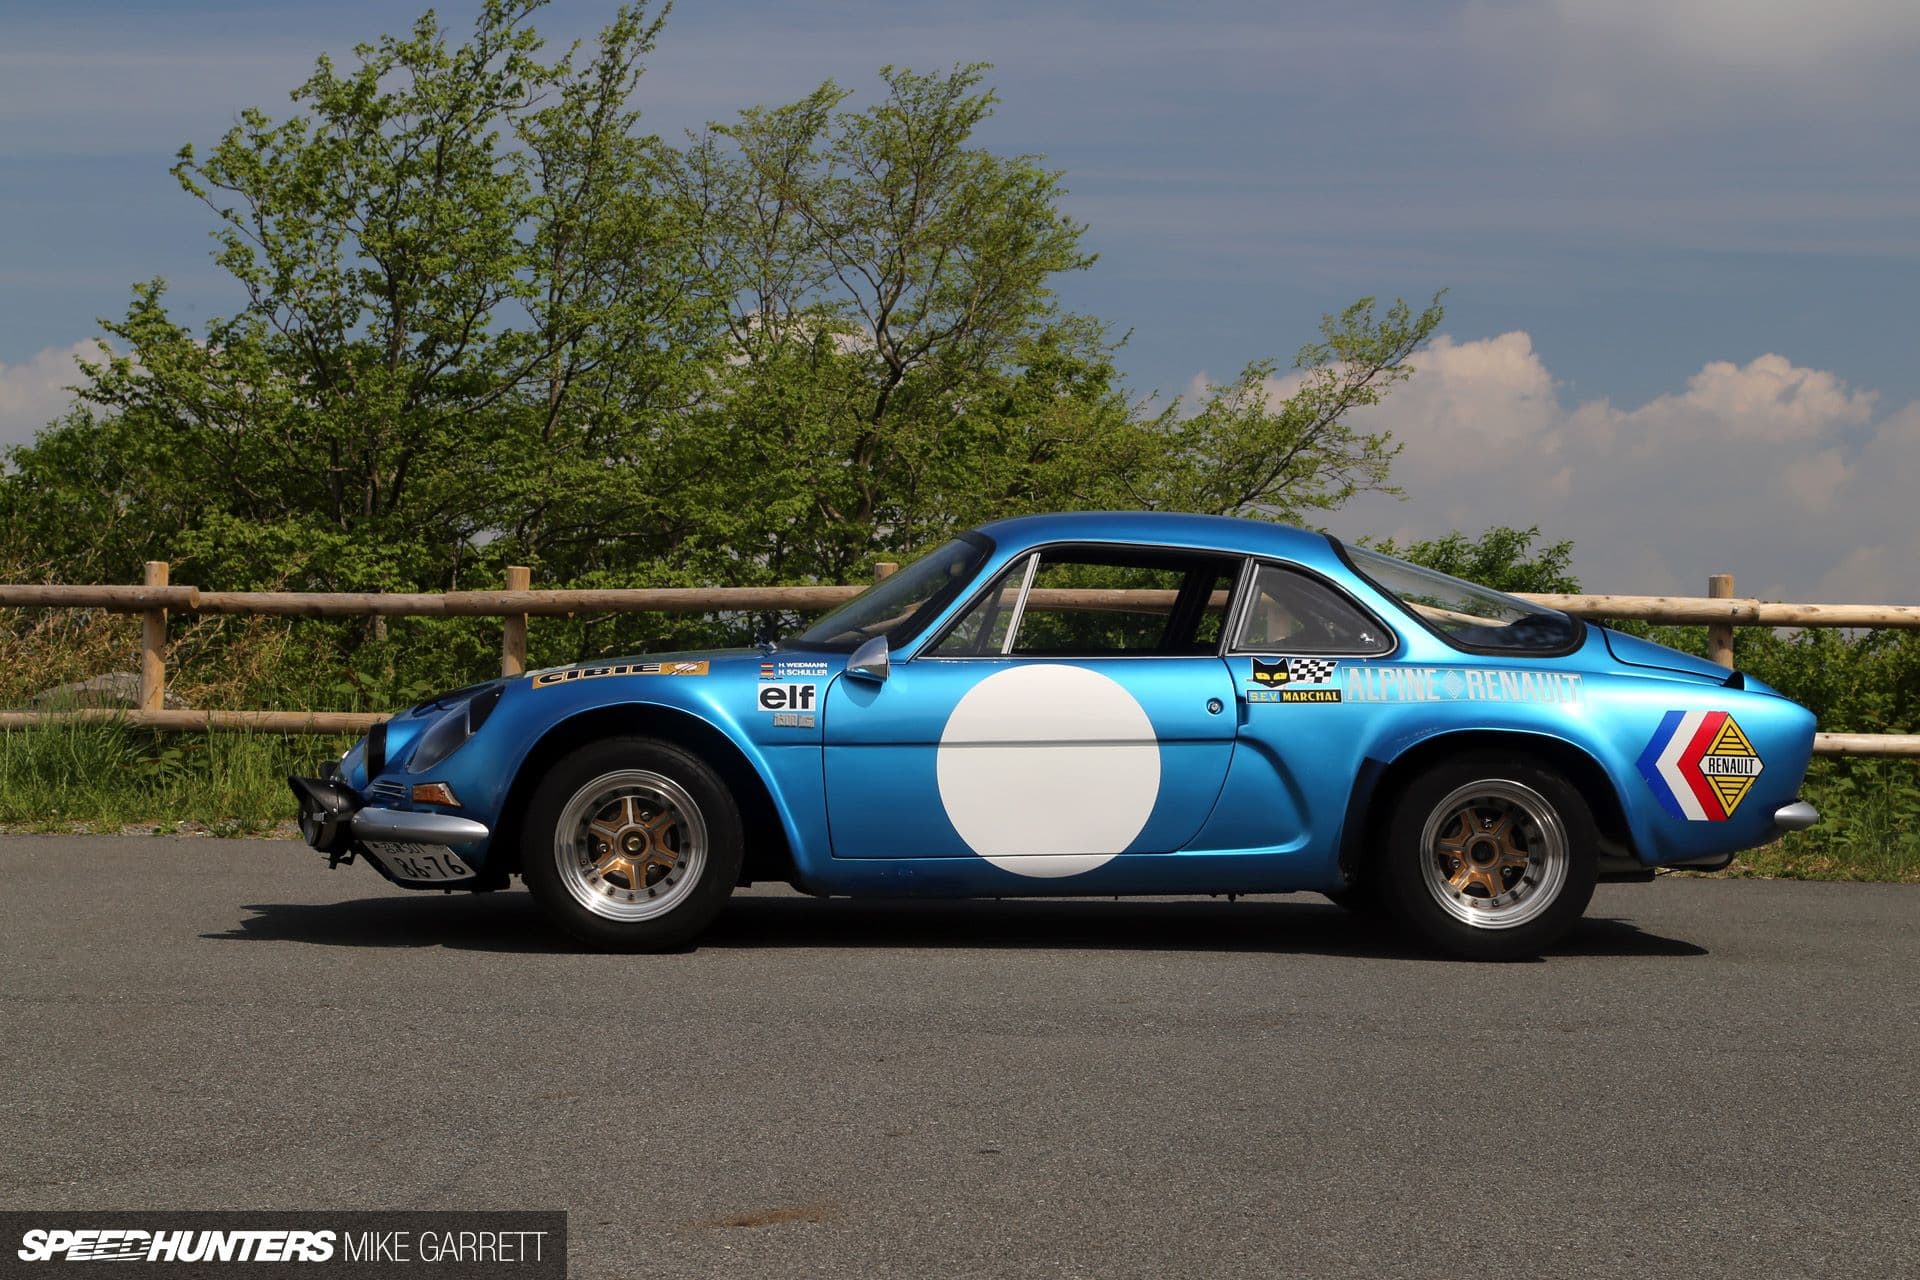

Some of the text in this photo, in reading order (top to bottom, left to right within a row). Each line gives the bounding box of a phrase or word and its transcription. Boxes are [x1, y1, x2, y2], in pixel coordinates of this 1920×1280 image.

[538, 664, 661, 684] CIBIE
[1349, 668, 1578, 703] ALPINE RENAULT
[760, 685, 814, 709] elf
[1282, 691, 1338, 701] MARCHAL
[1708, 757, 1755, 774] RENAULT
